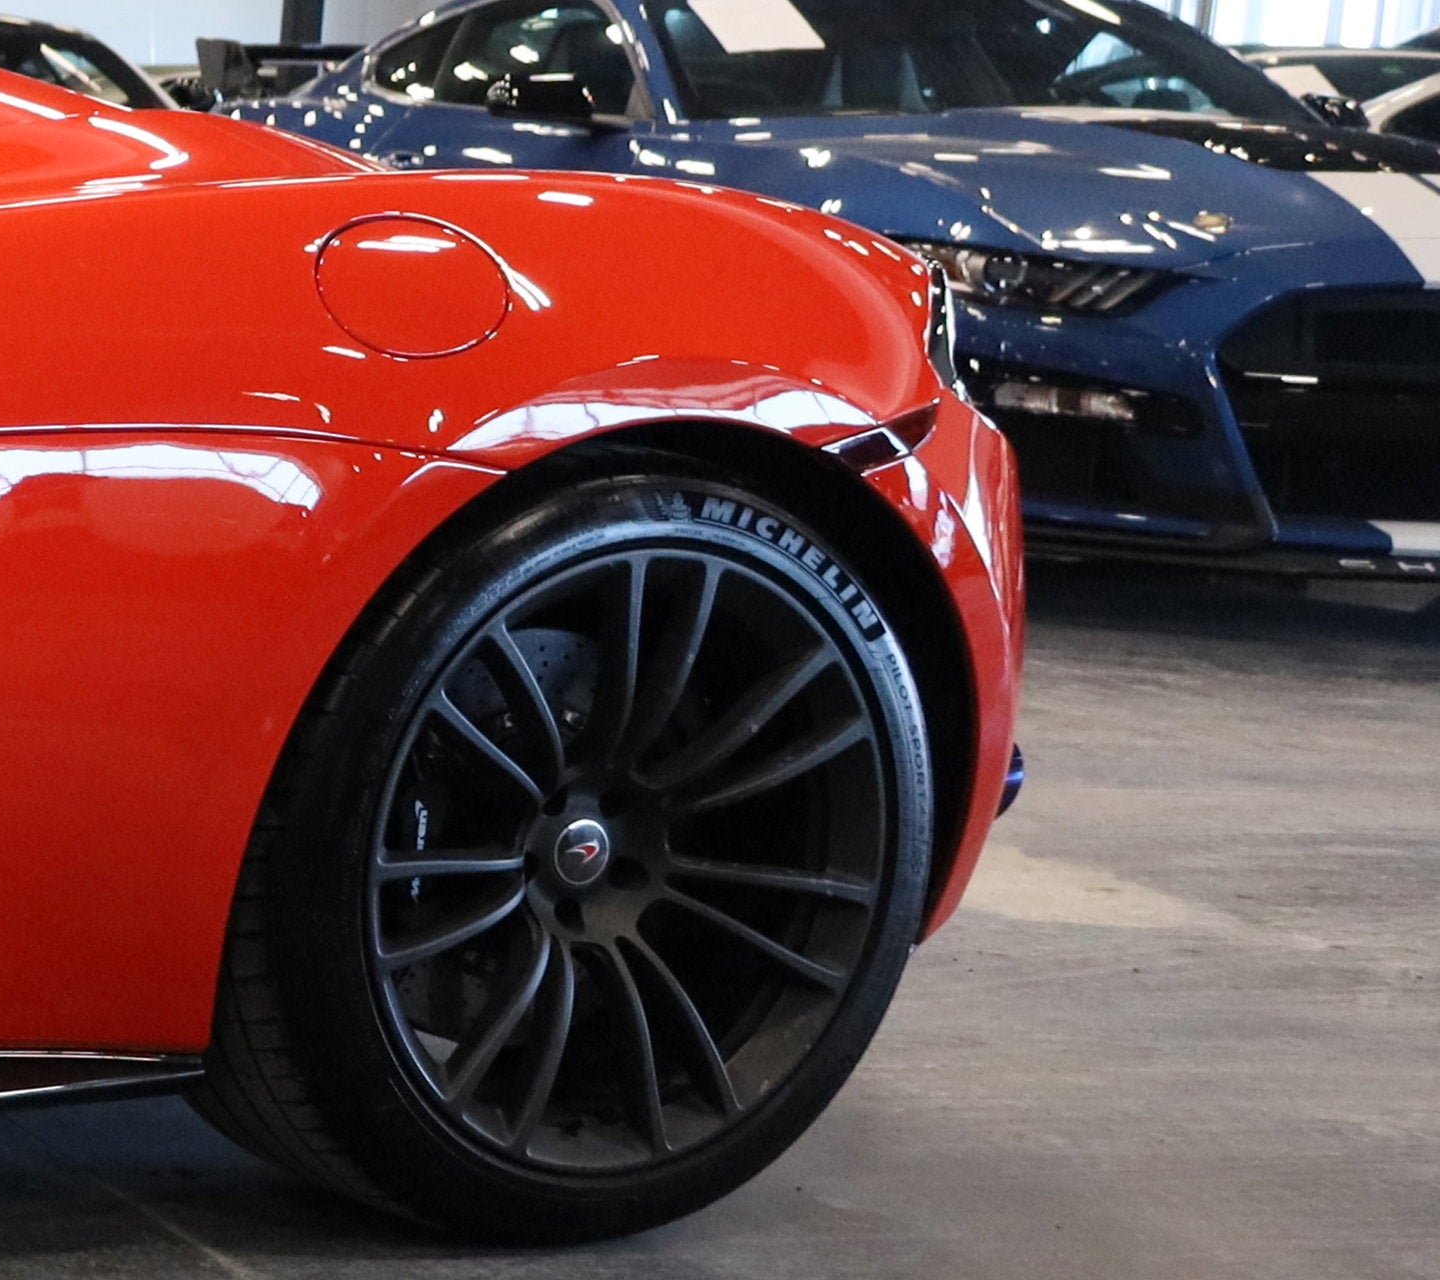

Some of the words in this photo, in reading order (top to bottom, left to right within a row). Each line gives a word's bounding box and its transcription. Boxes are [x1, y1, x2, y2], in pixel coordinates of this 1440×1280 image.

[701, 496, 879, 631] MICHELIN
[886, 653, 912, 711] PILOT
[909, 724, 927, 801] SPORT
